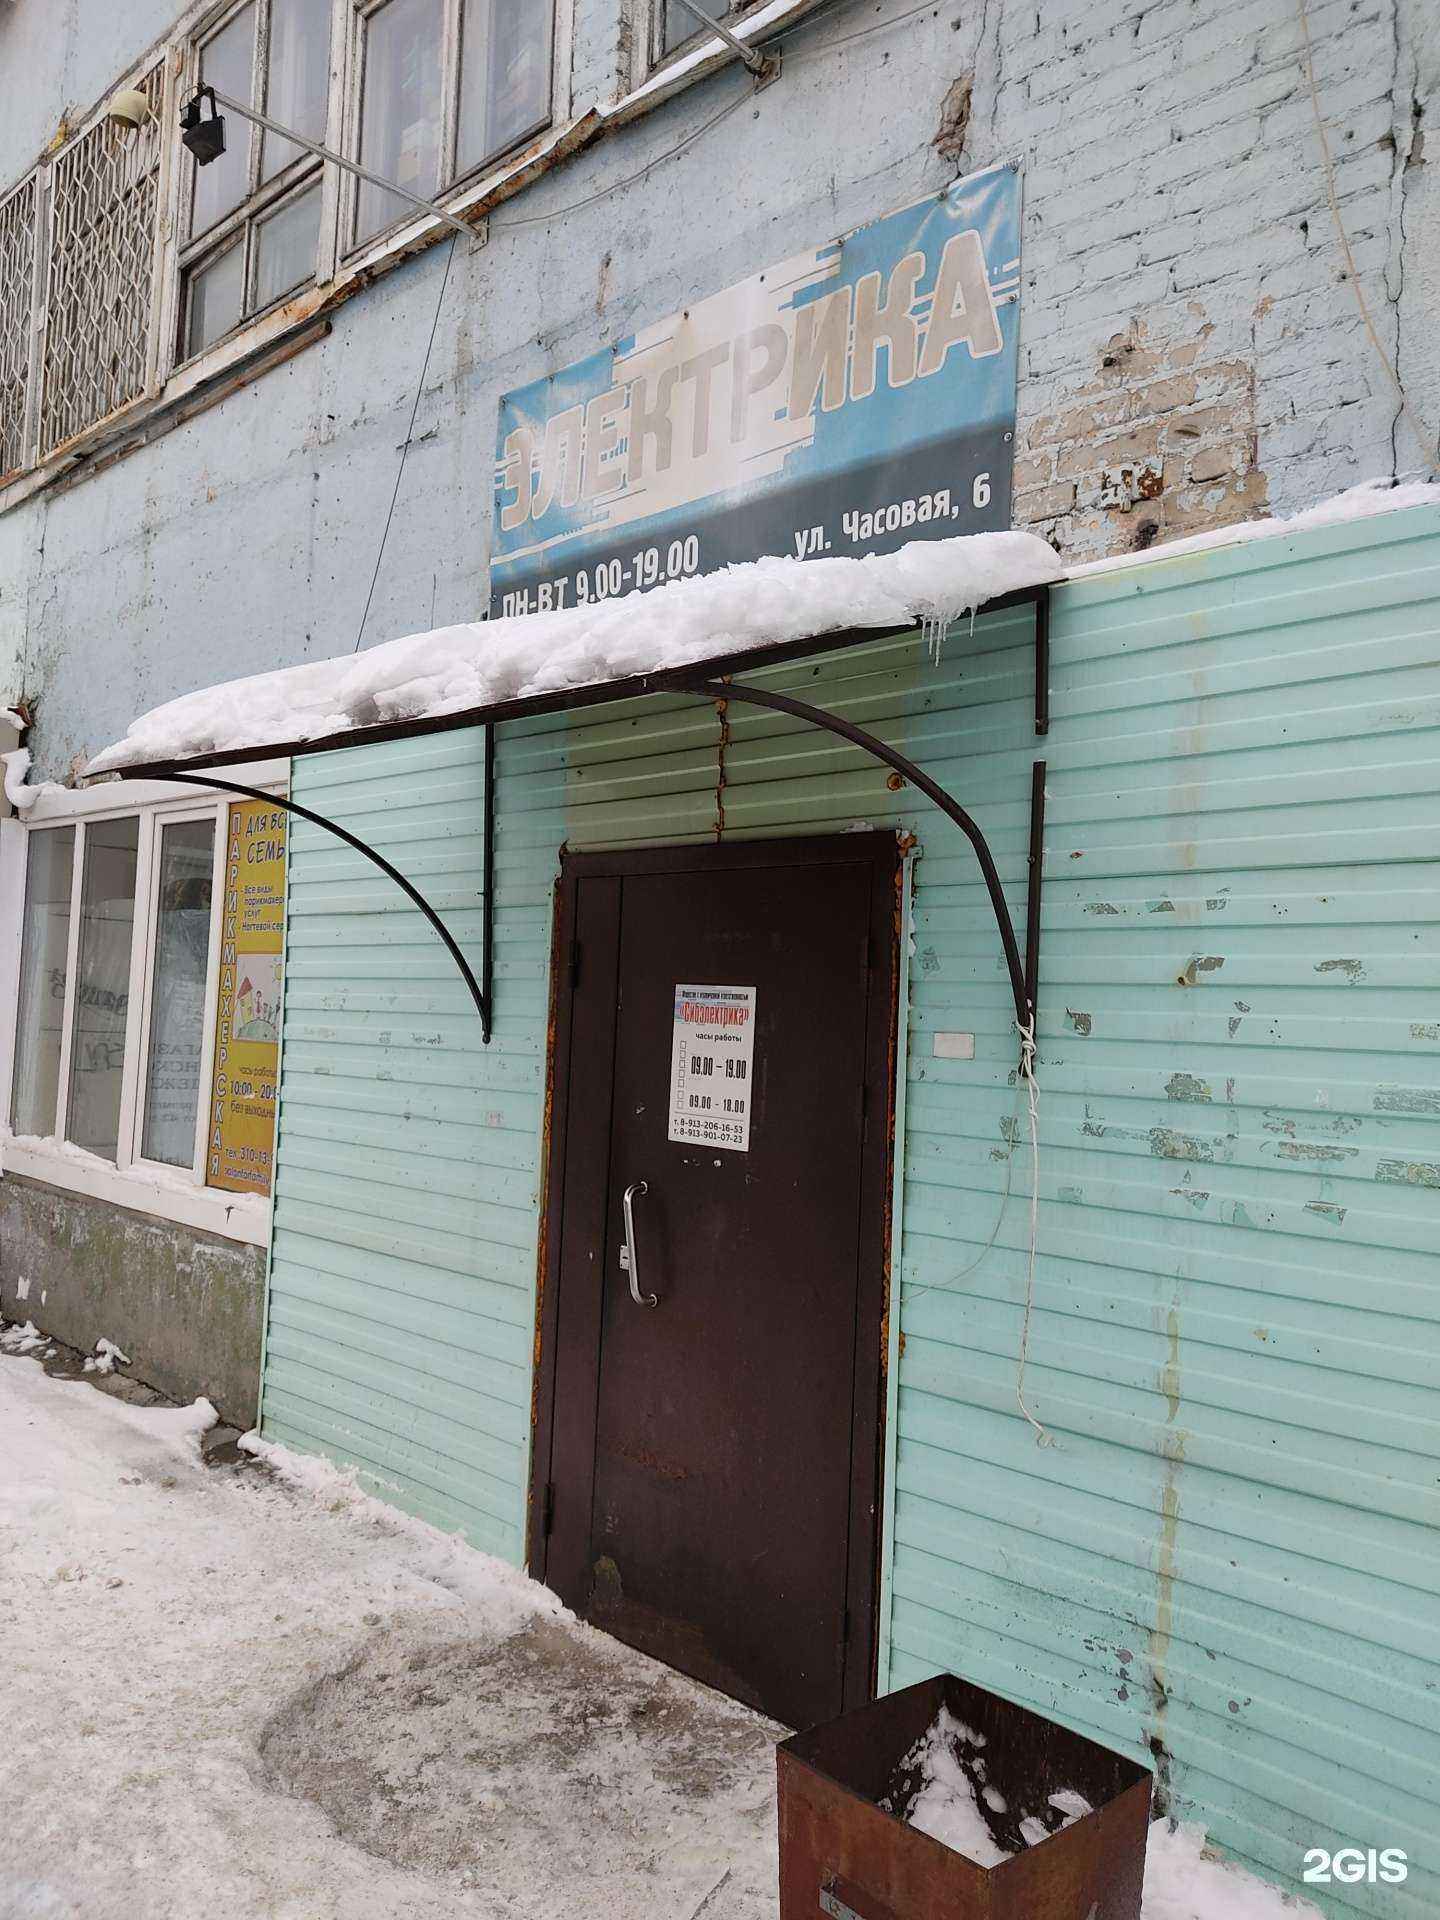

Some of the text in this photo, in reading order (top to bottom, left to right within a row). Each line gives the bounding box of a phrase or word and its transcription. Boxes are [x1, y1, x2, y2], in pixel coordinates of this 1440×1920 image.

[501, 229, 1003, 531] ЭЛЕКТРИКА
[795, 472, 991, 562] ул. Часовая, 6
[502, 535, 699, 618] ПН-ВТ 9.00-19.00
[210, 811, 242, 1176] ПАРИКМАХЕРСКАЯ
[691, 1055, 713, 1076] 09.00
[725, 1058, 747, 1079] 19.00
[695, 1032, 742, 1043] часы работы
